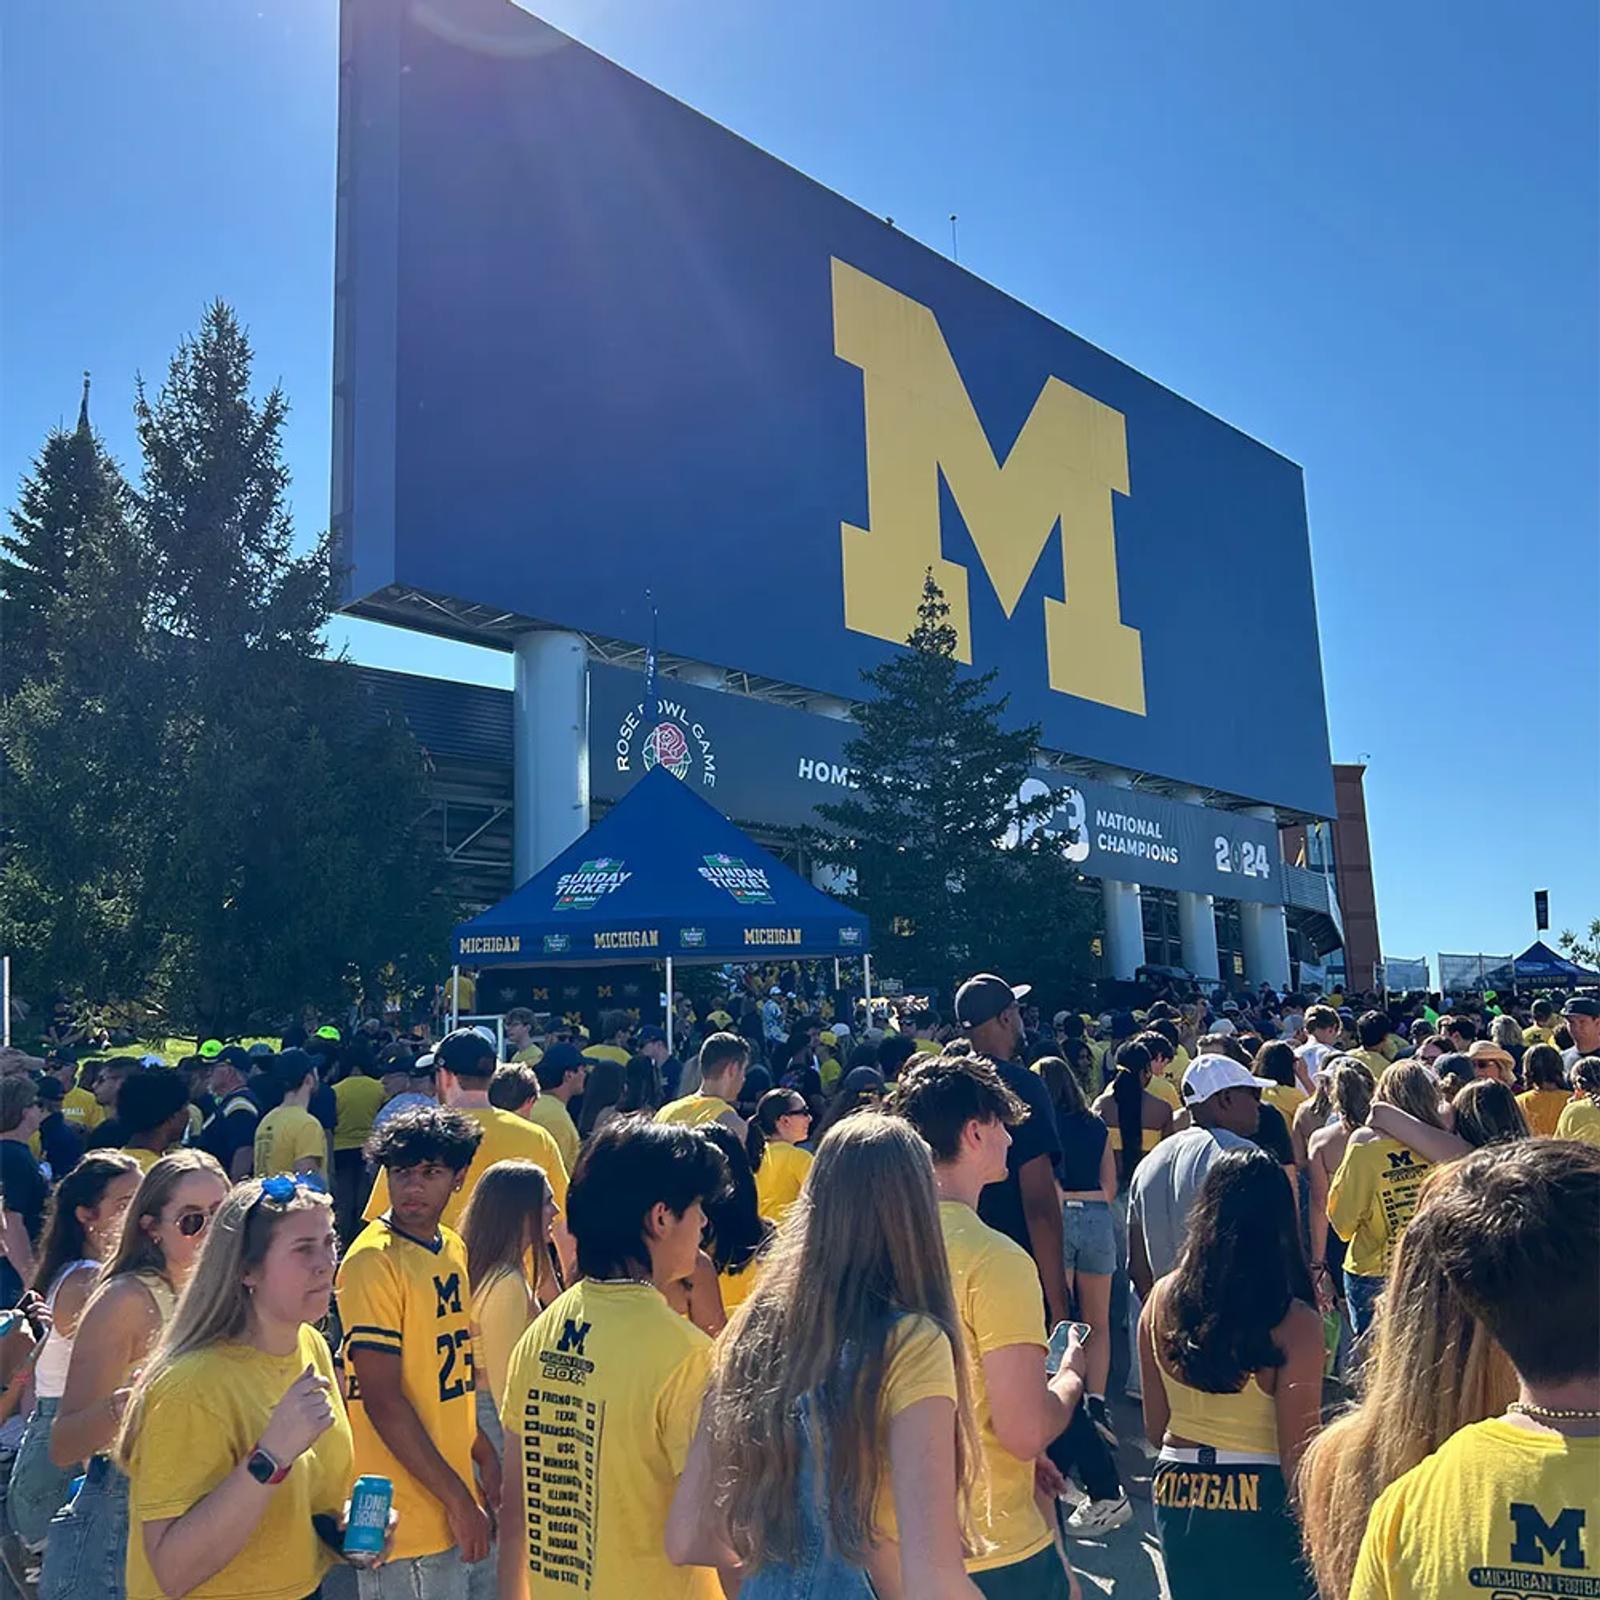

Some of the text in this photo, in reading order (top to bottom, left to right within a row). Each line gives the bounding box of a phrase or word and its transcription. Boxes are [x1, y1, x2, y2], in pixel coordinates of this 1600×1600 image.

[831, 256, 1147, 717] M
[616, 712, 640, 771] ROSE
[692, 723, 716, 787] GAME
[1096, 810, 1162, 839] NATIONAL
[1098, 833, 1179, 864] CHAMPIONS
[557, 872, 632, 885] SUNDAY
[697, 867, 766, 879] SUNDAY
[555, 883, 621, 896] TICKET
[708, 878, 771, 889] TICKET
[460, 936, 520, 953] MICHIGAN
[594, 930, 659, 949] MICHIGAN
[744, 928, 801, 945] MICHIGAN
[1387, 1150, 1414, 1169] M
[433, 1273, 462, 1318] M
[556, 1318, 592, 1356] M
[1510, 1503, 1585, 1569] M
[1480, 1570, 1552, 1590] MICHIGAN
